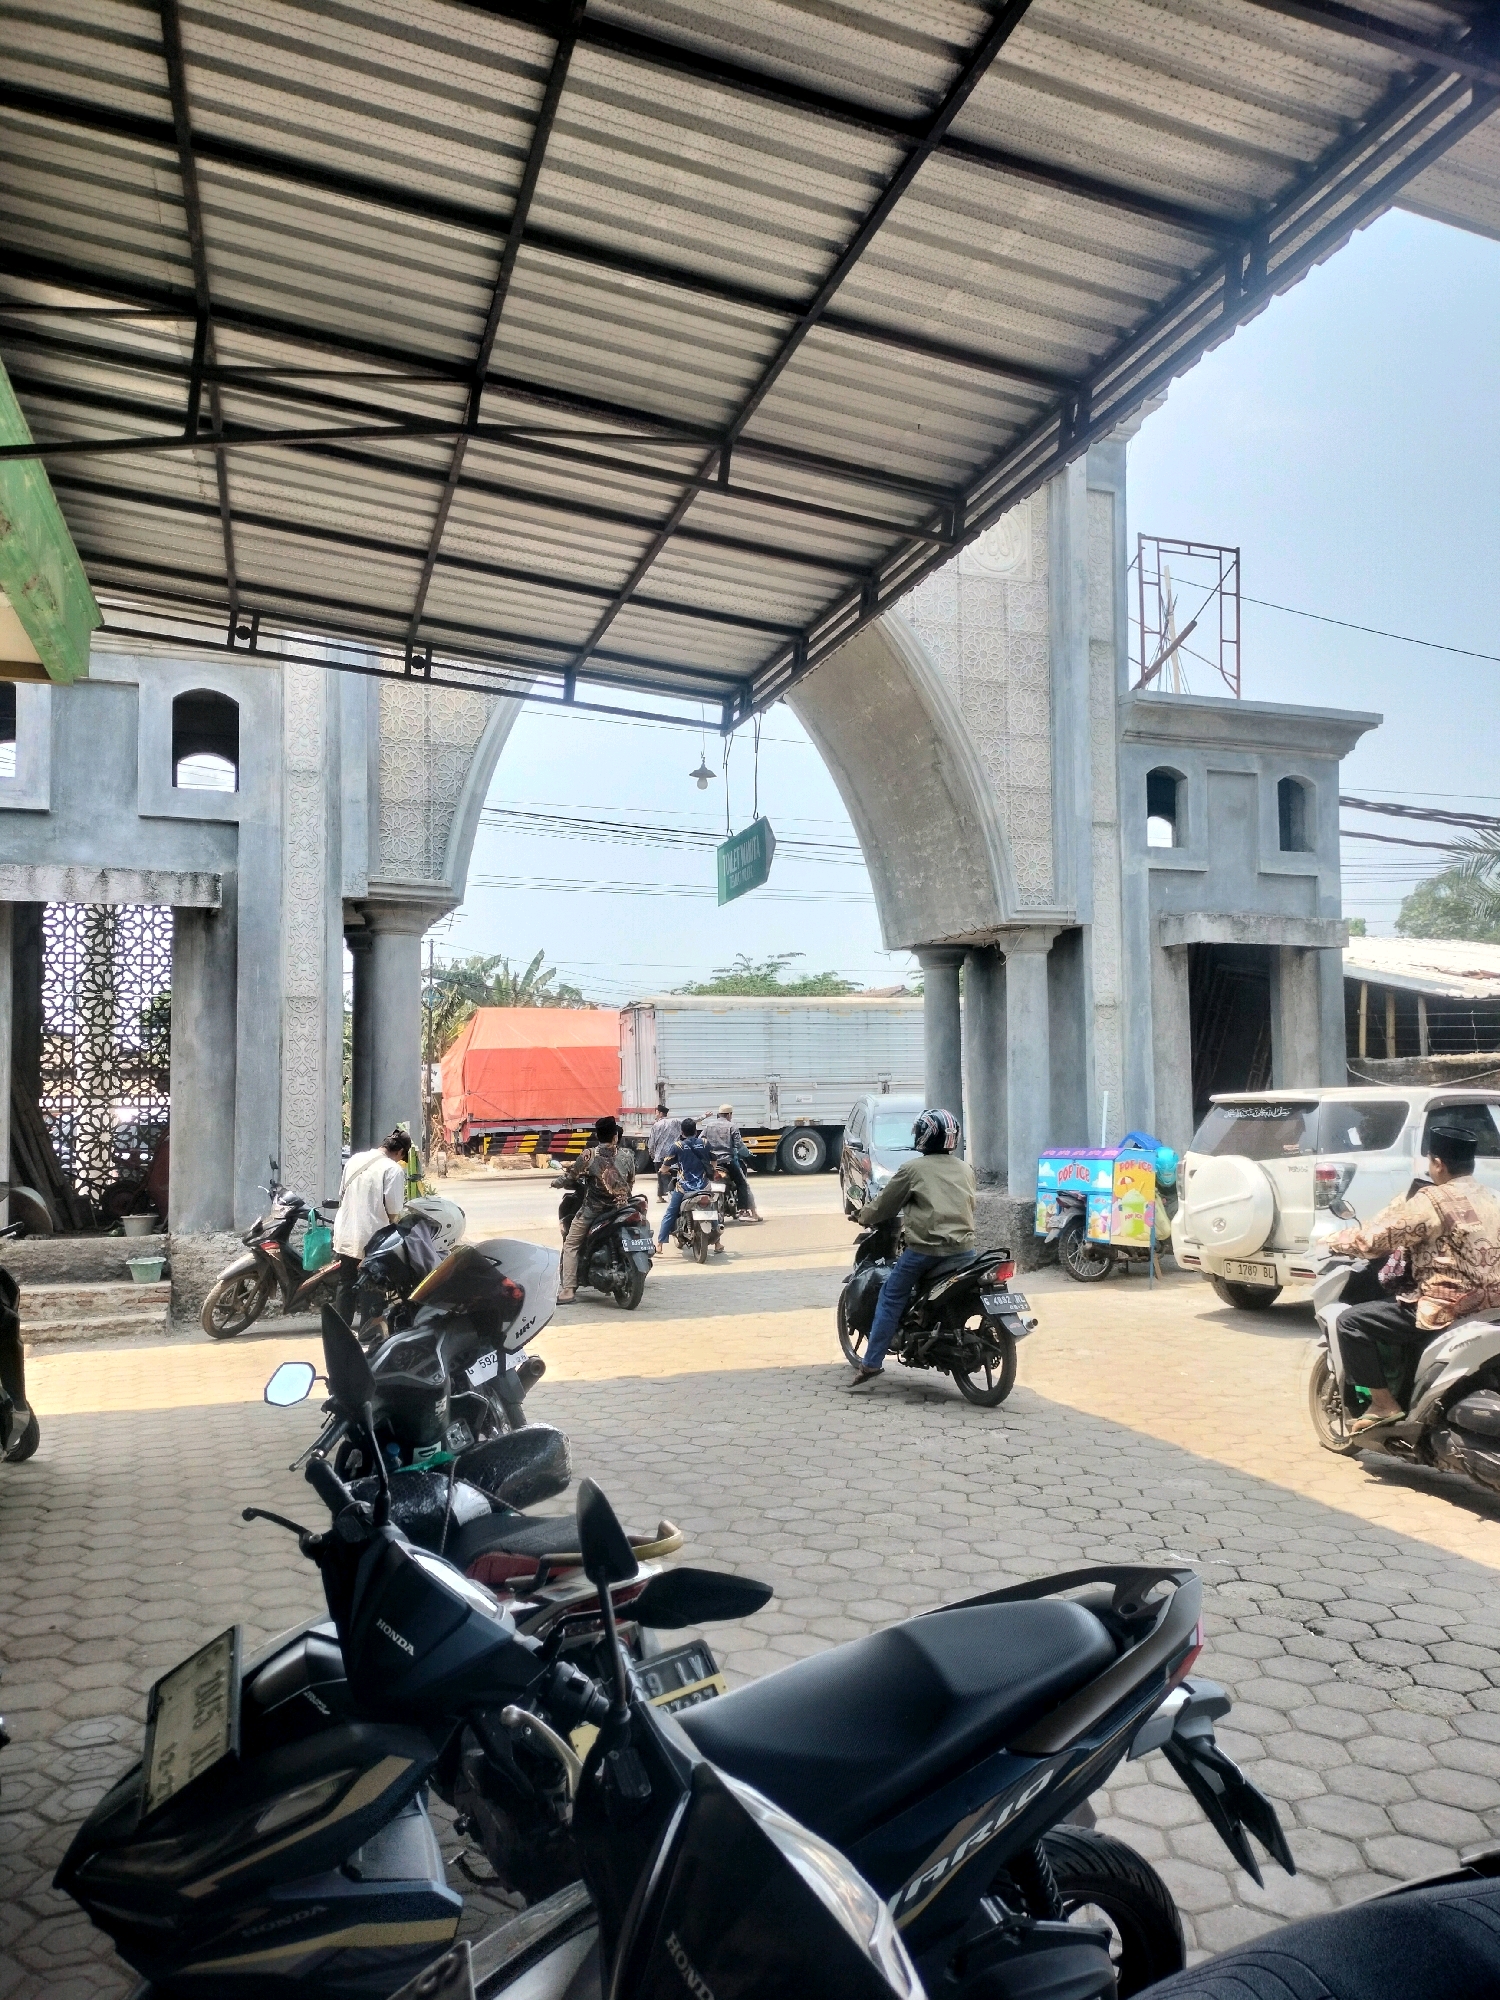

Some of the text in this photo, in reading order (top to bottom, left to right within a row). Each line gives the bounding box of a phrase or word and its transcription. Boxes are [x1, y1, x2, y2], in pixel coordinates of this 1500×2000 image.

[723, 847, 740, 876] TOILET
[1058, 1163, 1090, 1186] POP ICE
[1119, 1160, 1135, 1172] POP
[1238, 1264, 1258, 1277] 1789
[1263, 1266, 1274, 1279] BL
[515, 1316, 536, 1339] HRV
[376, 1617, 415, 1657] HONDA
